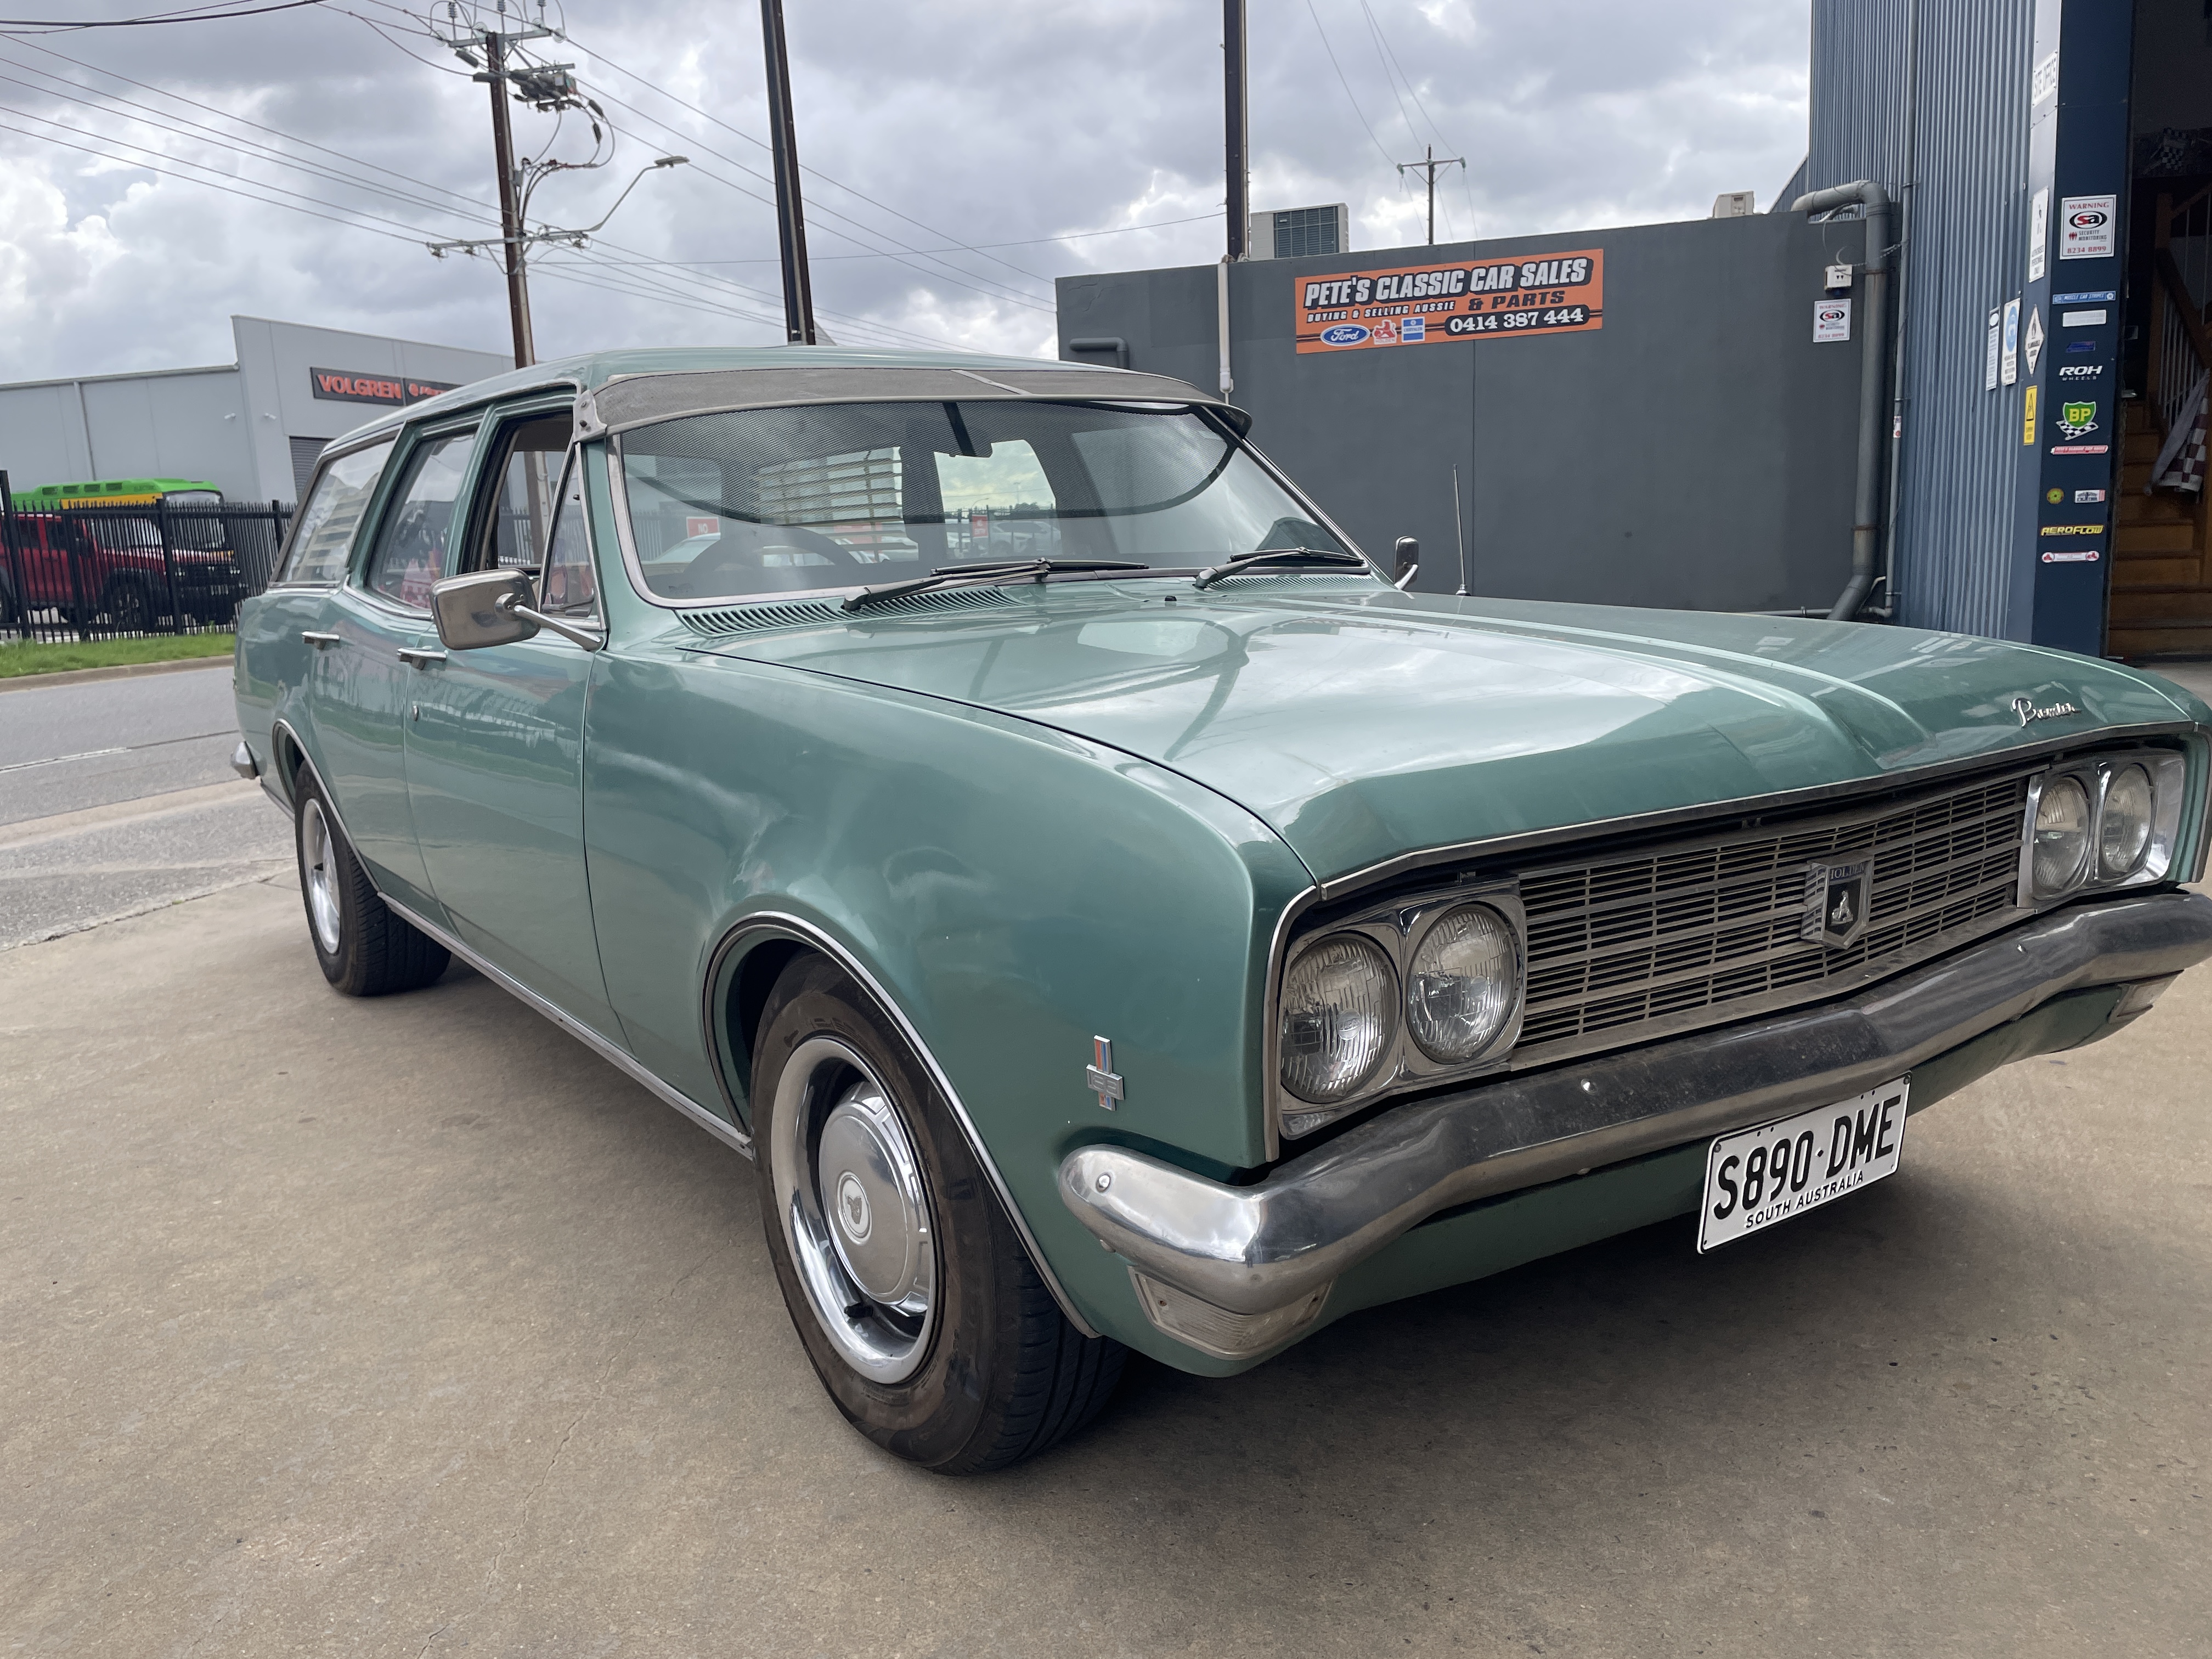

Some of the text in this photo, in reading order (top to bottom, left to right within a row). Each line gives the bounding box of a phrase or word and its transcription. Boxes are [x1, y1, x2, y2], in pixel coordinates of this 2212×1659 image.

[2069, 201, 2109, 210] WARNING
[1305, 258, 1587, 307] PETE'S CLASSIC CAR SALES
[1468, 290, 1565, 311] & PARTS
[1307, 310, 1347, 323] BUYING
[1364, 304, 1409, 318] SELLING
[1414, 301, 1455, 314] AUSSIE
[1450, 307, 1583, 332] 0414 387 444
[1330, 328, 1359, 342] Ford
[2059, 365, 2103, 376] ROH
[318, 374, 402, 399] VOLGREN
[2068, 408, 2091, 422] BP
[2041, 524, 2104, 536] AEROFLOW
[1745, 1170, 1864, 1228] SOUTH AUSTRALIA
